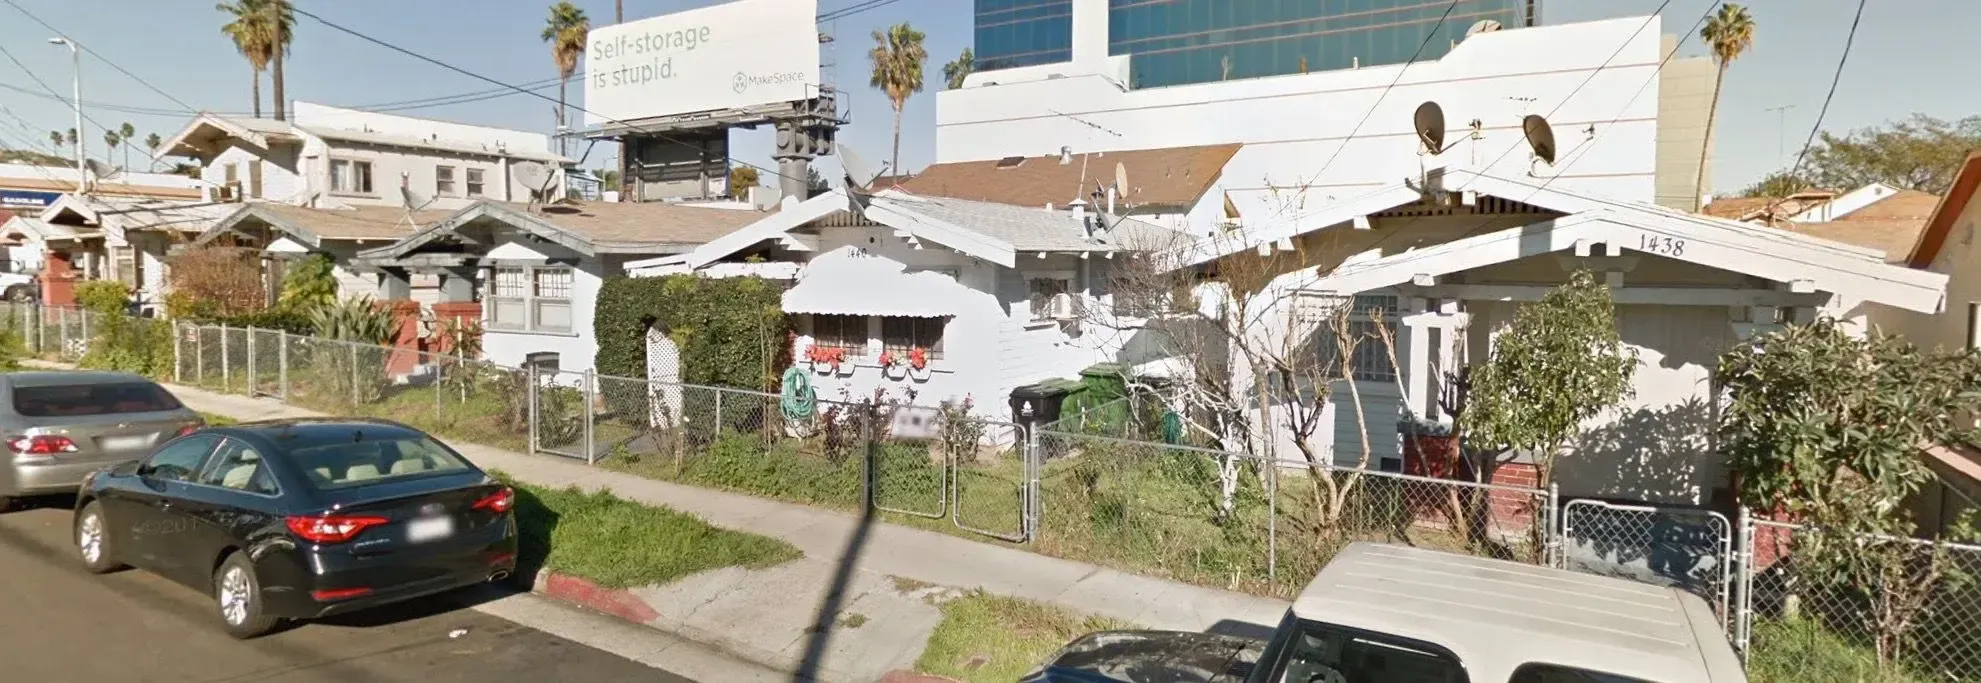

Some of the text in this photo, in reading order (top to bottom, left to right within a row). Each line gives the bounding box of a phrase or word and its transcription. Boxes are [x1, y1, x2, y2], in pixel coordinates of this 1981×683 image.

[593, 24, 711, 61] Self-storage
[593, 57, 678, 89] is stupid.
[748, 71, 805, 87] MakeSpace
[847, 248, 868, 258] 1440
[1639, 233, 1685, 257] 1438
